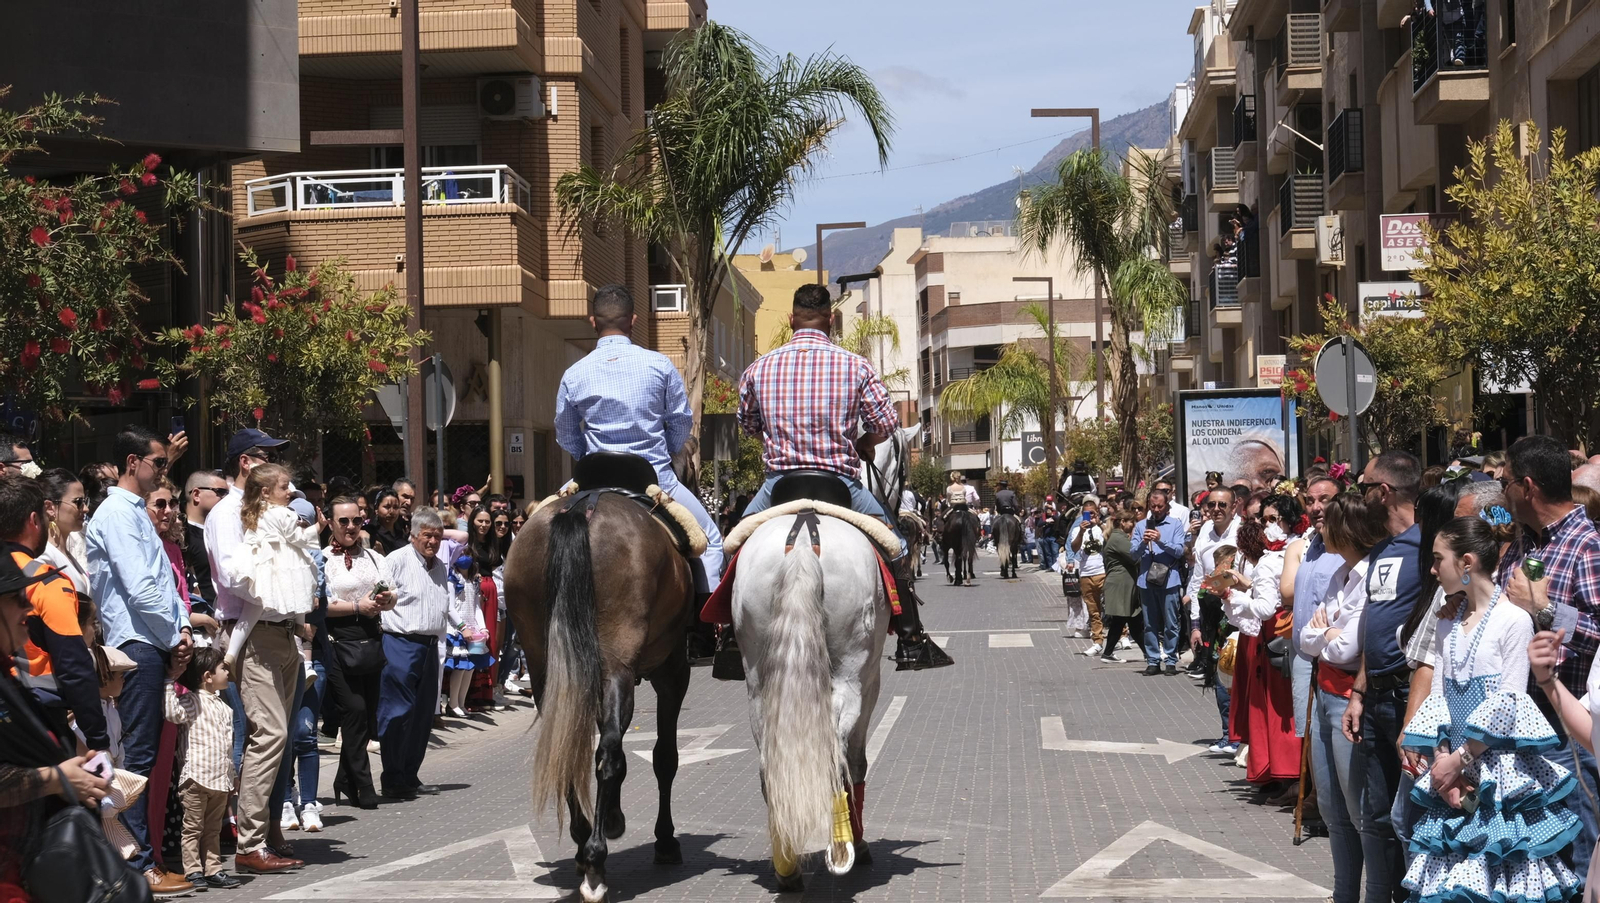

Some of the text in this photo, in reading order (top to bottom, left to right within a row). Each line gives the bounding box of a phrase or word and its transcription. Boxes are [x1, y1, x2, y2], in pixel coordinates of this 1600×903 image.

[1192, 418, 1276, 428] NUESTRA INDIFERENCIA
[1192, 427, 1242, 437] LOS CONDENA
[1191, 437, 1230, 446] AL OLVIDO
